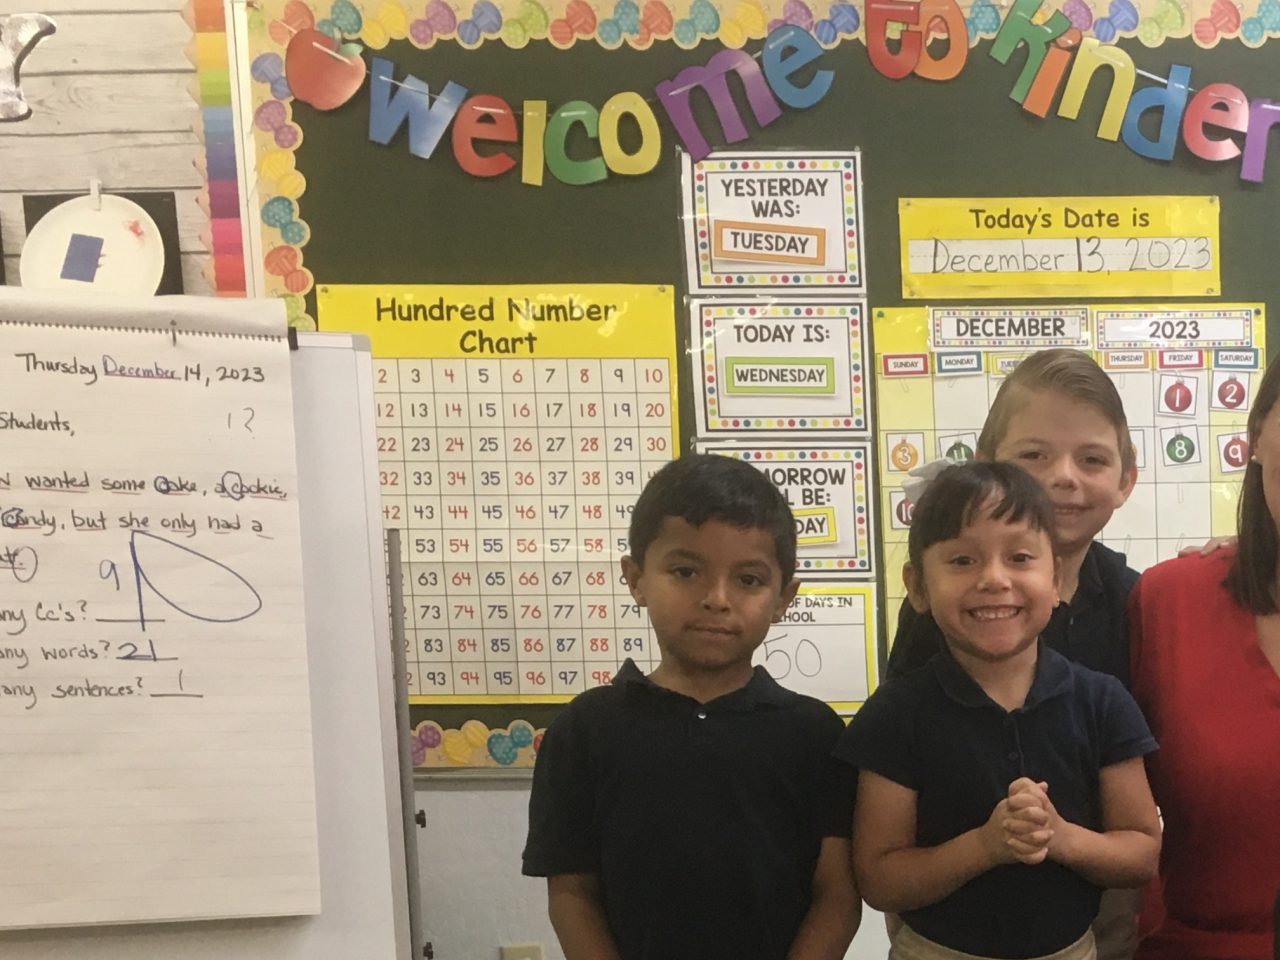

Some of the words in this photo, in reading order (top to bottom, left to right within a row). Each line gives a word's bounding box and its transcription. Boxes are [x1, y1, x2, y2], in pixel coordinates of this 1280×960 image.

[368, 23, 836, 187] welcome
[721, 178, 828, 197] YESTERDAY
[751, 199, 800, 218] WAS:
[969, 208, 1052, 235] Today's
[1064, 208, 1120, 229] Date
[1131, 207, 1150, 228] is
[731, 231, 809, 254] TUESDAY
[931, 237, 1064, 274] December
[1125, 236, 1211, 271] 2023
[376, 297, 495, 322] Hundred
[508, 297, 617, 322] Number
[733, 324, 795, 343] TODAY
[803, 324, 830, 342] IS:
[956, 318, 1065, 338] DECEMBER
[1149, 321, 1200, 339] 2023
[459, 329, 537, 354] Chart
[15, 352, 98, 385] Thursday
[102, 354, 181, 381] December
[218, 366, 266, 383] 2023
[378, 369, 387, 383] 2
[411, 369, 420, 383] 3
[445, 369, 454, 383] 4
[478, 369, 489, 383] 5
[513, 369, 523, 383] 6
[546, 368, 555, 383] 7
[580, 369, 589, 383] 8
[614, 369, 623, 382] 9
[646, 369, 663, 383] 10
[735, 368, 825, 383] WEDNESDAY
[1175, 388, 1181, 407] 1
[1225, 384, 1238, 403] 2
[378, 403, 394, 417] 12
[412, 403, 428, 417] 13
[446, 403, 462, 417] 14
[479, 403, 496, 417] 15
[513, 404, 530, 417] 16
[547, 403, 563, 417] 17
[580, 403, 596, 417] 18
[614, 403, 630, 417] 19
[646, 403, 664, 417] 20
[377, 437, 396, 452] 22
[411, 437, 430, 452] 23
[446, 437, 464, 452] 24
[479, 437, 498, 452] 25
[513, 438, 532, 452] 26
[546, 437, 565, 452] 27
[581, 437, 598, 452] 28
[614, 437, 632, 451] 29
[647, 437, 666, 451] 30
[900, 447, 911, 465] 3
[1175, 439, 1188, 459] 8
[1228, 443, 1243, 463] 9
[25, 471, 90, 489] wanted
[101, 477, 146, 491] some
[380, 472, 398, 486] 32
[413, 471, 432, 485] 33
[447, 472, 466, 485] 34
[481, 471, 500, 485] 35
[515, 472, 534, 485] 36
[548, 471, 567, 485] 37
[582, 471, 600, 485] 38
[615, 471, 634, 485] 39
[802, 488, 831, 506] BE:
[73, 509, 107, 530] but
[119, 511, 149, 529] she
[160, 512, 196, 538] only
[208, 514, 240, 530] had
[252, 520, 263, 532] a
[805, 597, 833, 607] DAYS
[837, 597, 852, 608] IN
[41, 640, 110, 660] words?
[116, 639, 157, 662] 21
[51, 677, 143, 699] sentences?
